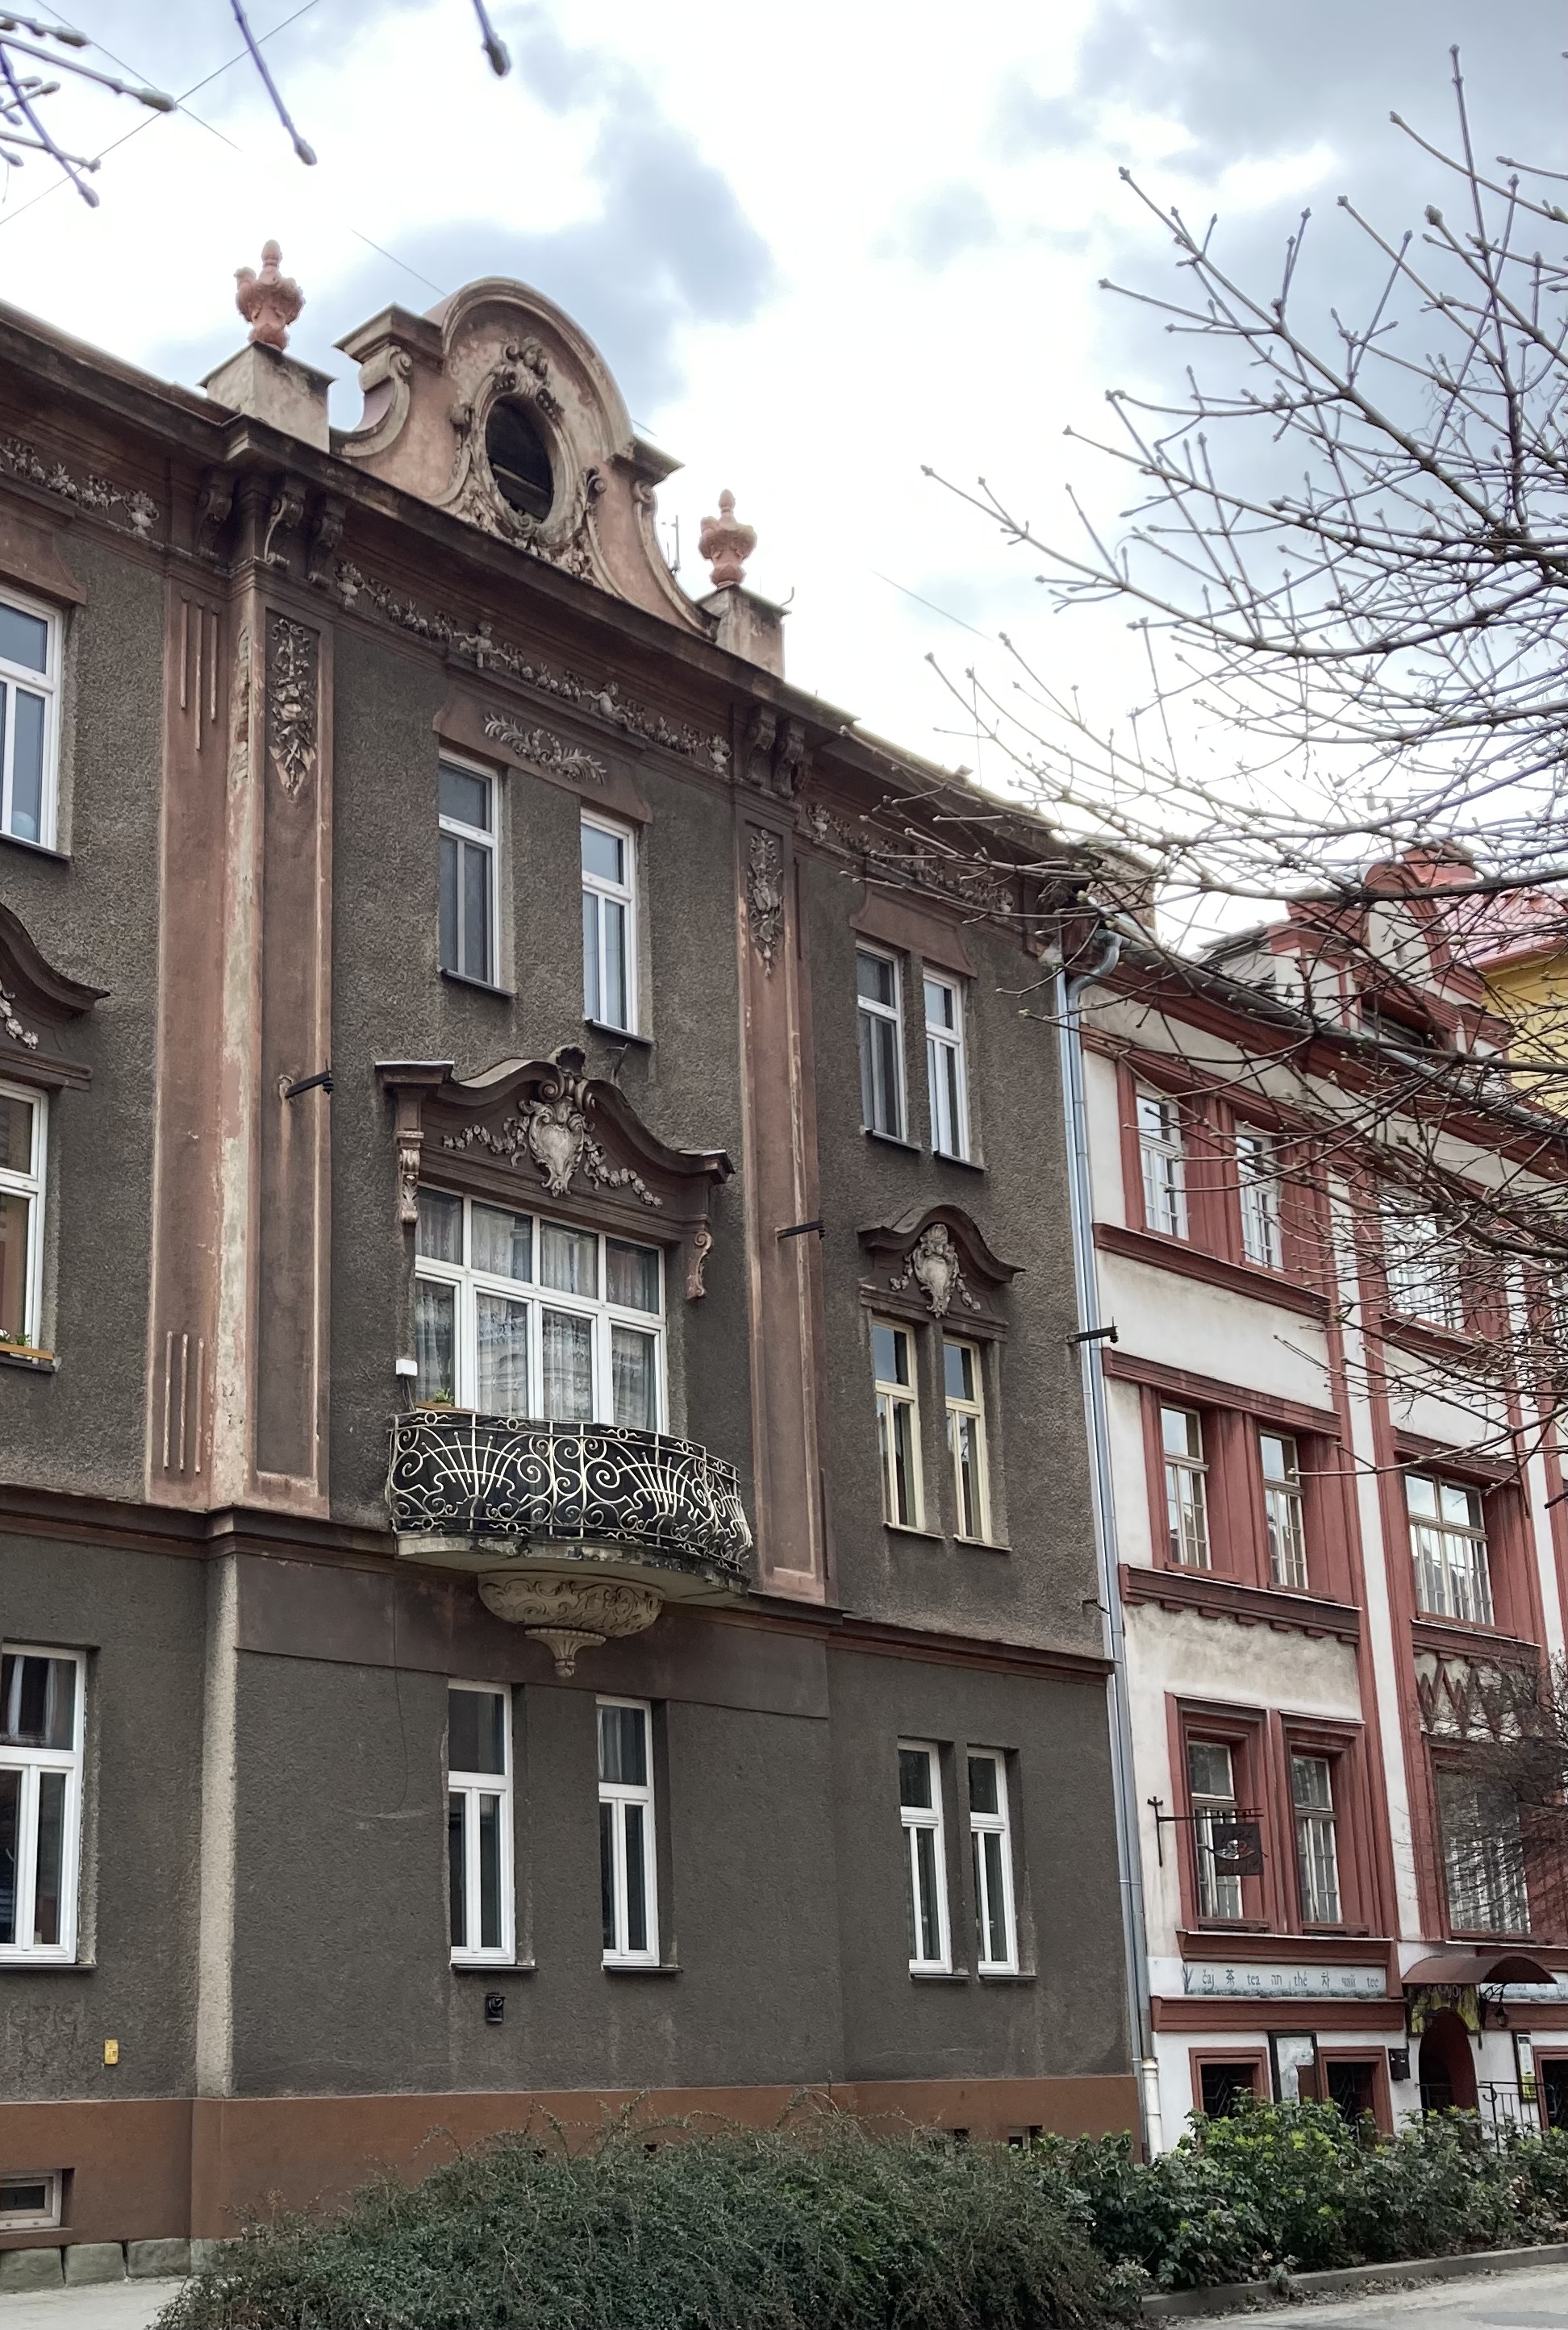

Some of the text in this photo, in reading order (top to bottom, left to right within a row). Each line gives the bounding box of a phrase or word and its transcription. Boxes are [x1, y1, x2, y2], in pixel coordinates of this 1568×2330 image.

[1225, 1969, 1235, 1988] 茶
[1246, 1974, 1261, 1986] tea
[1293, 1970, 1307, 1986] thé
[1366, 1976, 1379, 1988] tee
